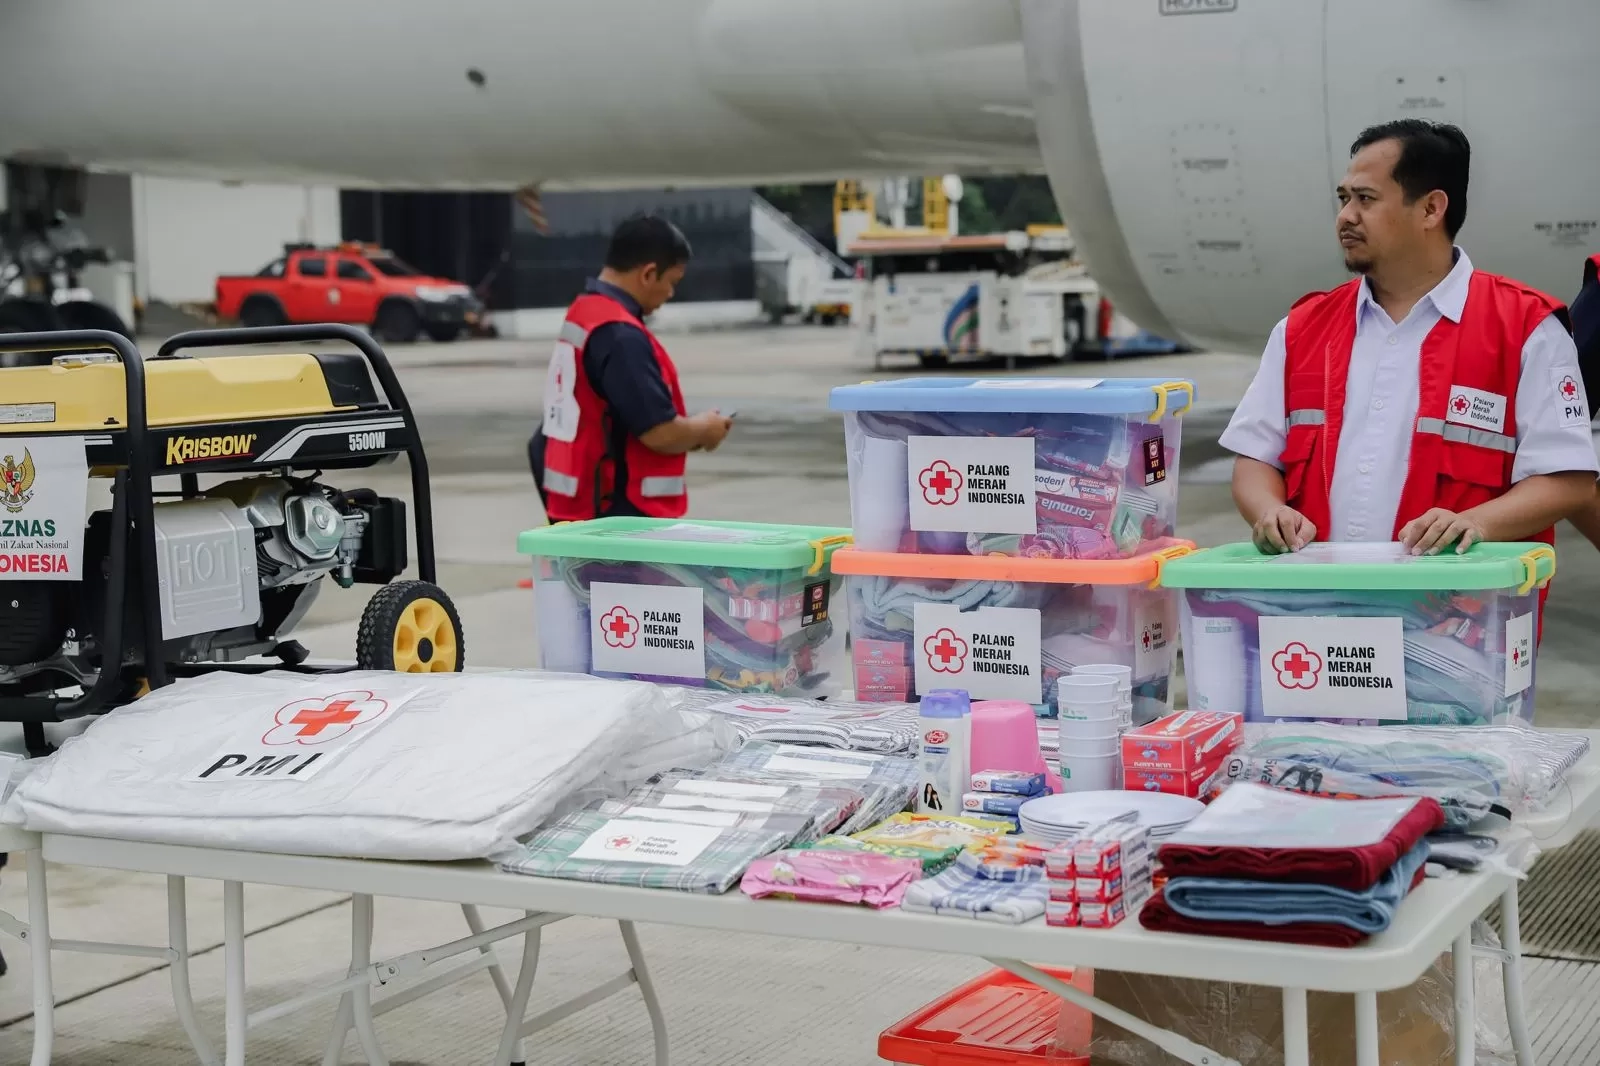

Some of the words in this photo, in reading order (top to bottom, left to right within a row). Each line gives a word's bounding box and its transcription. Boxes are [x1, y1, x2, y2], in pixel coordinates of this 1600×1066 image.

[1472, 403, 1490, 414] Merah
[1473, 396, 1495, 408] Palang
[1470, 410, 1499, 425] Indonesia
[348, 431, 386, 452] 5500W
[967, 464, 1010, 477] PALANG
[967, 478, 1007, 491] MERAH
[967, 492, 1026, 506] INDONESIA
[1041, 498, 1095, 521] Formula
[0, 519, 56, 537] ZNAS
[10, 540, 34, 549] Zakat
[36, 540, 69, 549] Nasional
[0, 554, 69, 573] ONESIA
[173, 538, 237, 588] HOT
[643, 610, 682, 624] PALANG
[643, 623, 679, 637] MERAH
[643, 636, 695, 651] INDONESIA
[972, 633, 1015, 647] PALANG
[972, 647, 1012, 661] MERAH
[1327, 646, 1376, 659] PALANG
[972, 661, 1030, 676] INDONESIA
[1327, 660, 1373, 674] MERAH
[1328, 675, 1394, 690] INDONESIA
[198, 752, 324, 778] PMI
[635, 847, 678, 856] Indonesia
